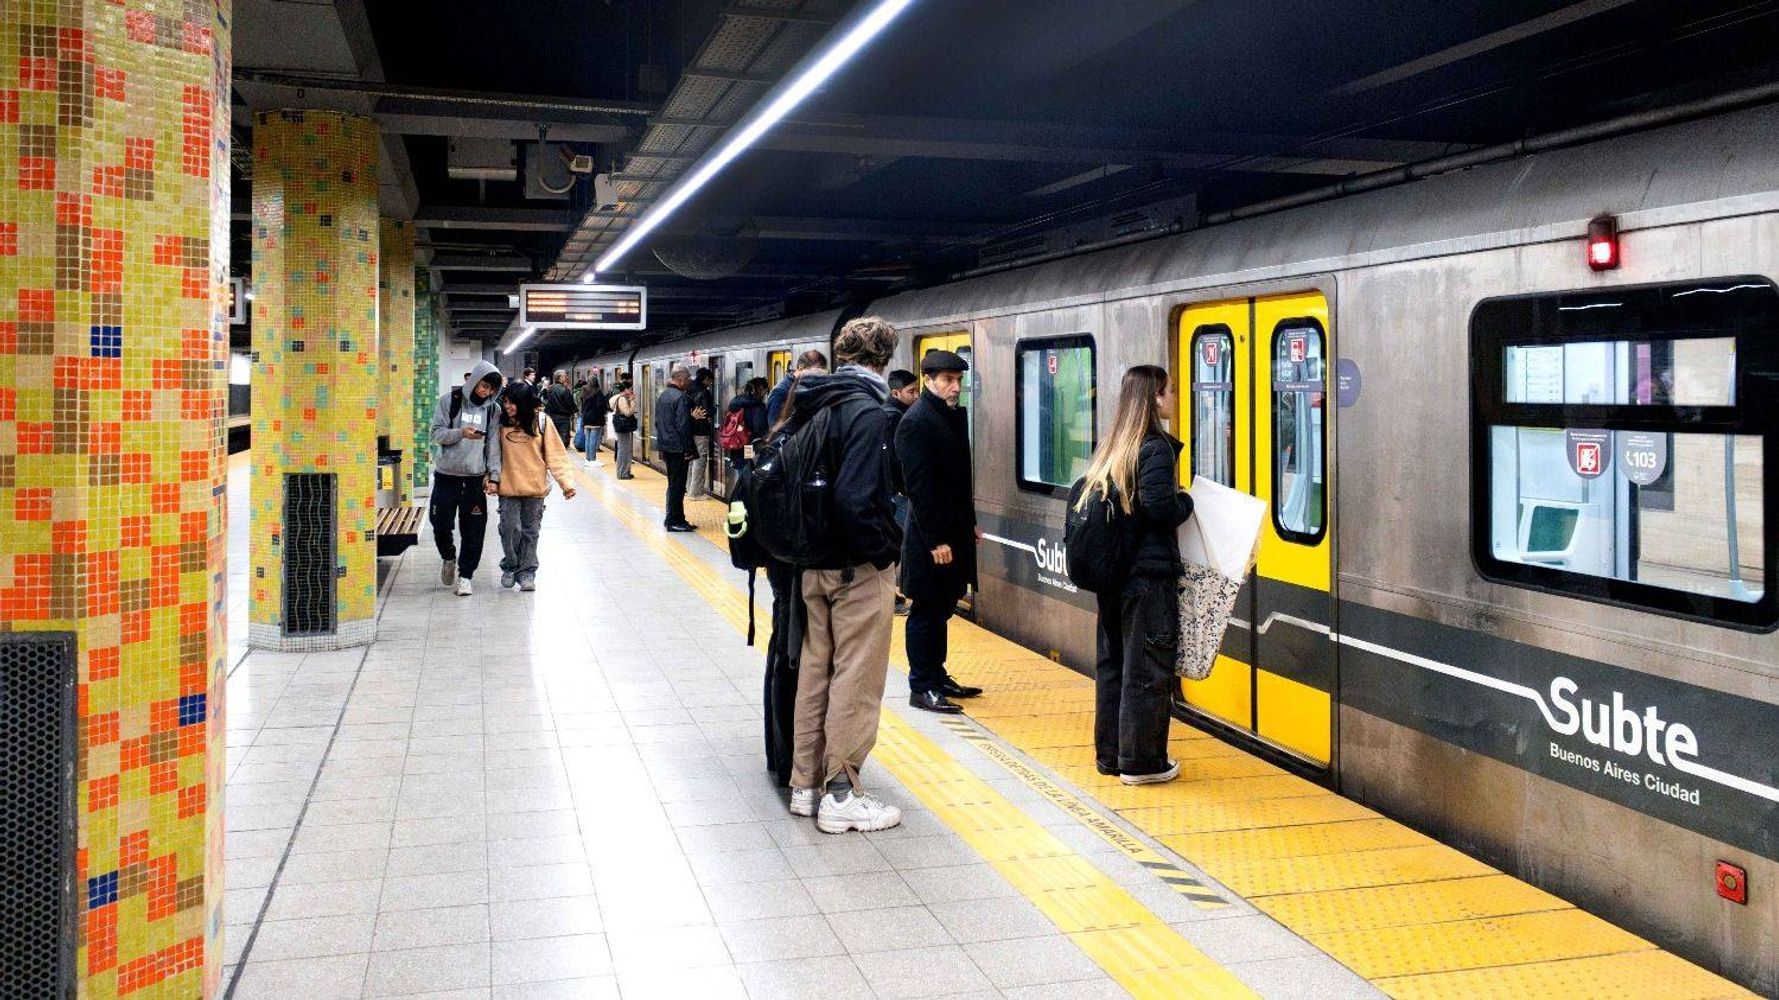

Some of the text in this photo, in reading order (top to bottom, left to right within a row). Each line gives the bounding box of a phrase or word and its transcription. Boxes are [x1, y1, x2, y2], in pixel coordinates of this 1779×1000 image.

[1633, 452, 1657, 468] 103
[1037, 537, 1068, 577] Subt
[1549, 676, 1699, 772] Subte
[1550, 742, 1700, 806] Buenos Aires Ciudad
